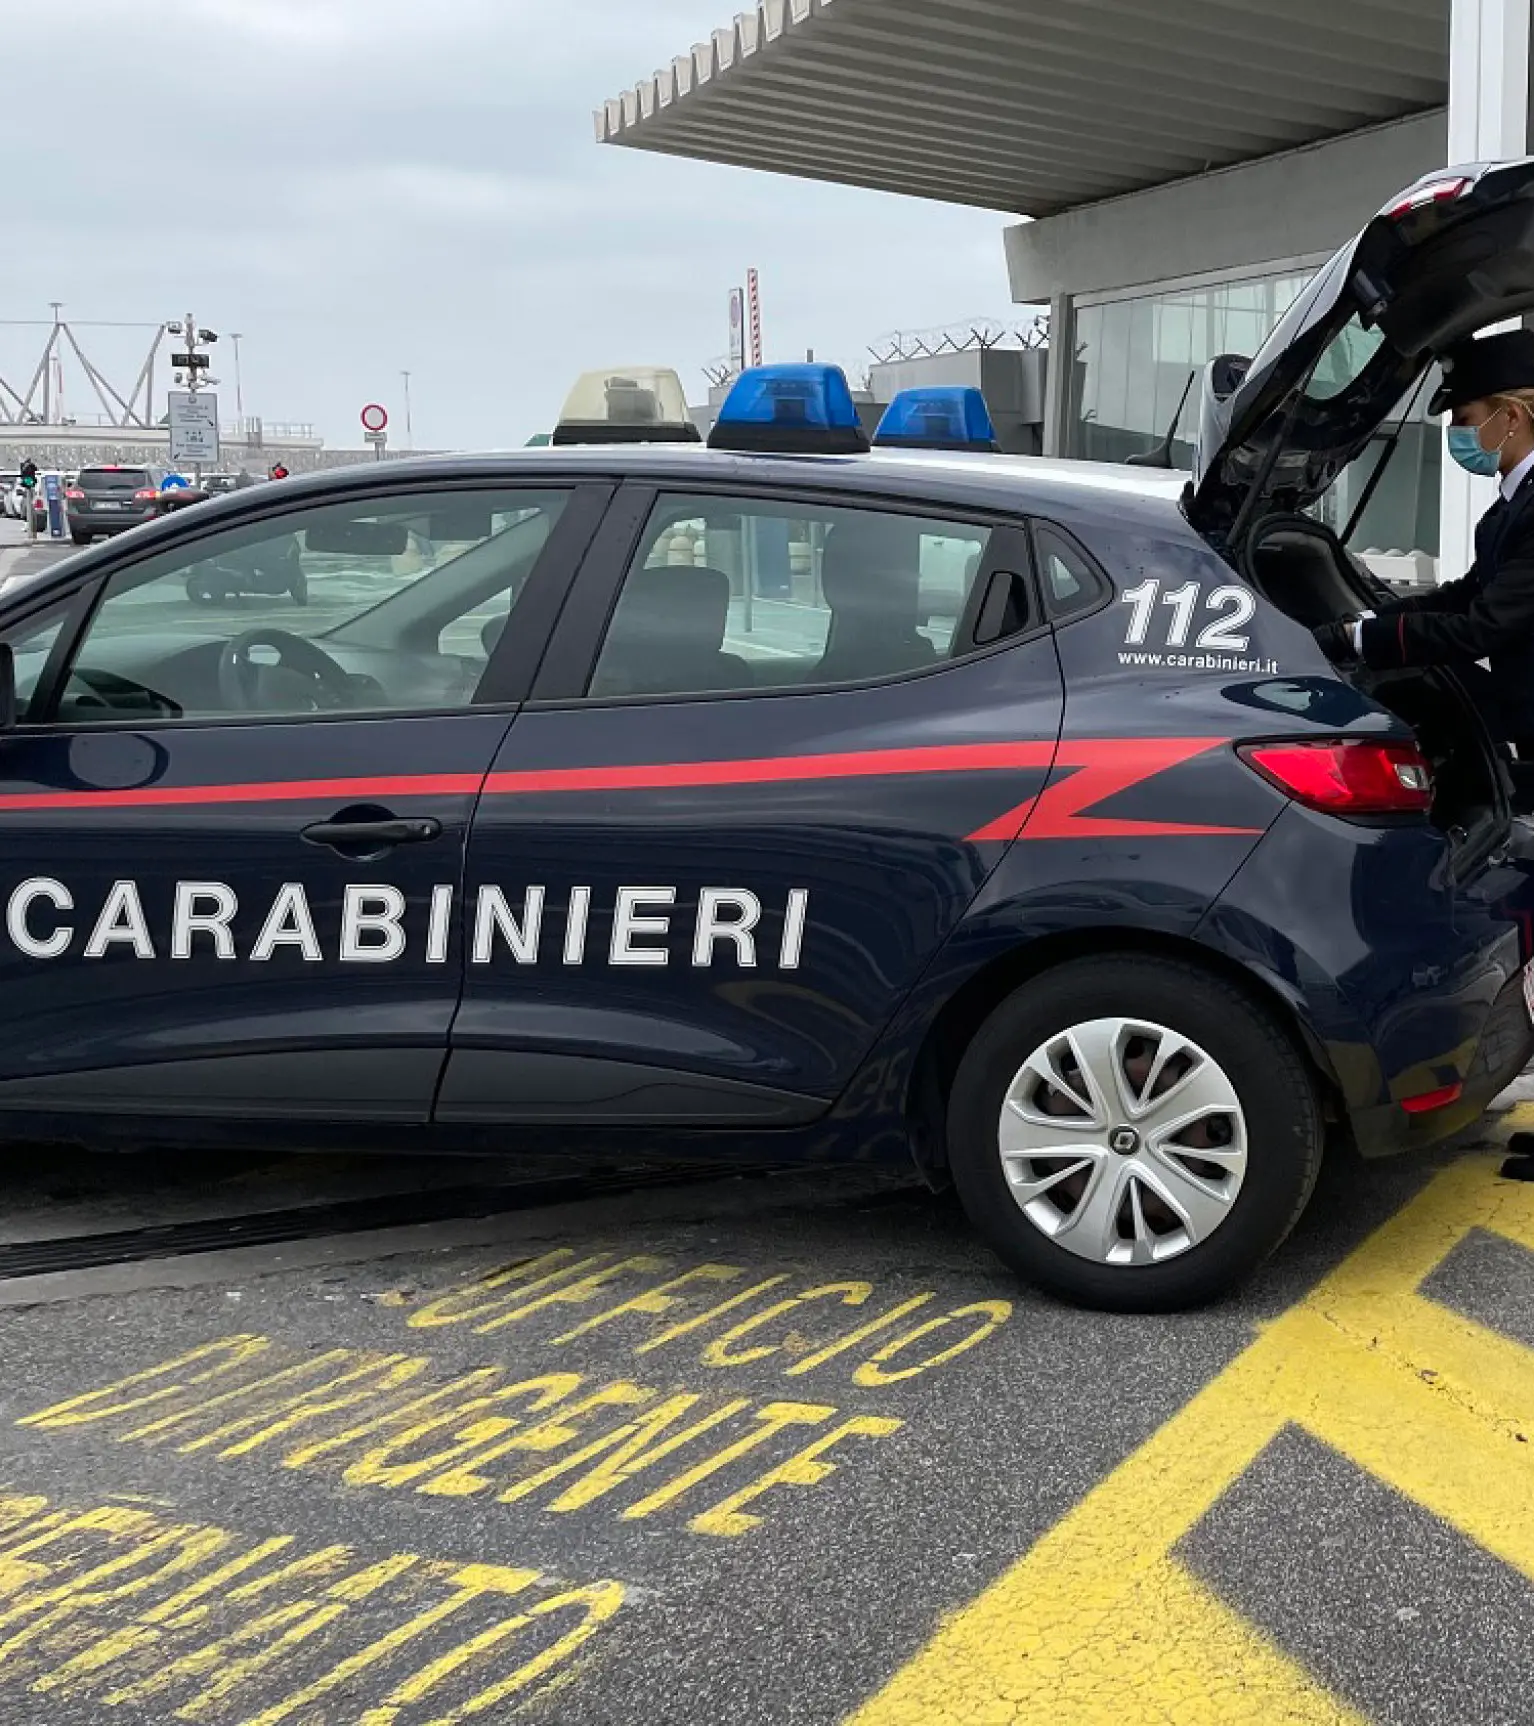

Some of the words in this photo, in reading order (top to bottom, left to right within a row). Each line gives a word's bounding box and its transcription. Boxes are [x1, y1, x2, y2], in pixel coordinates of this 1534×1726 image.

[1122, 579, 1256, 651] 112
[1117, 652, 1279, 674] www.carabinieri.it
[6, 877, 809, 968] CARABINIERI
[406, 1249, 1013, 1386] UFFICIO
[15, 1333, 904, 1537] DIRIGENTE
